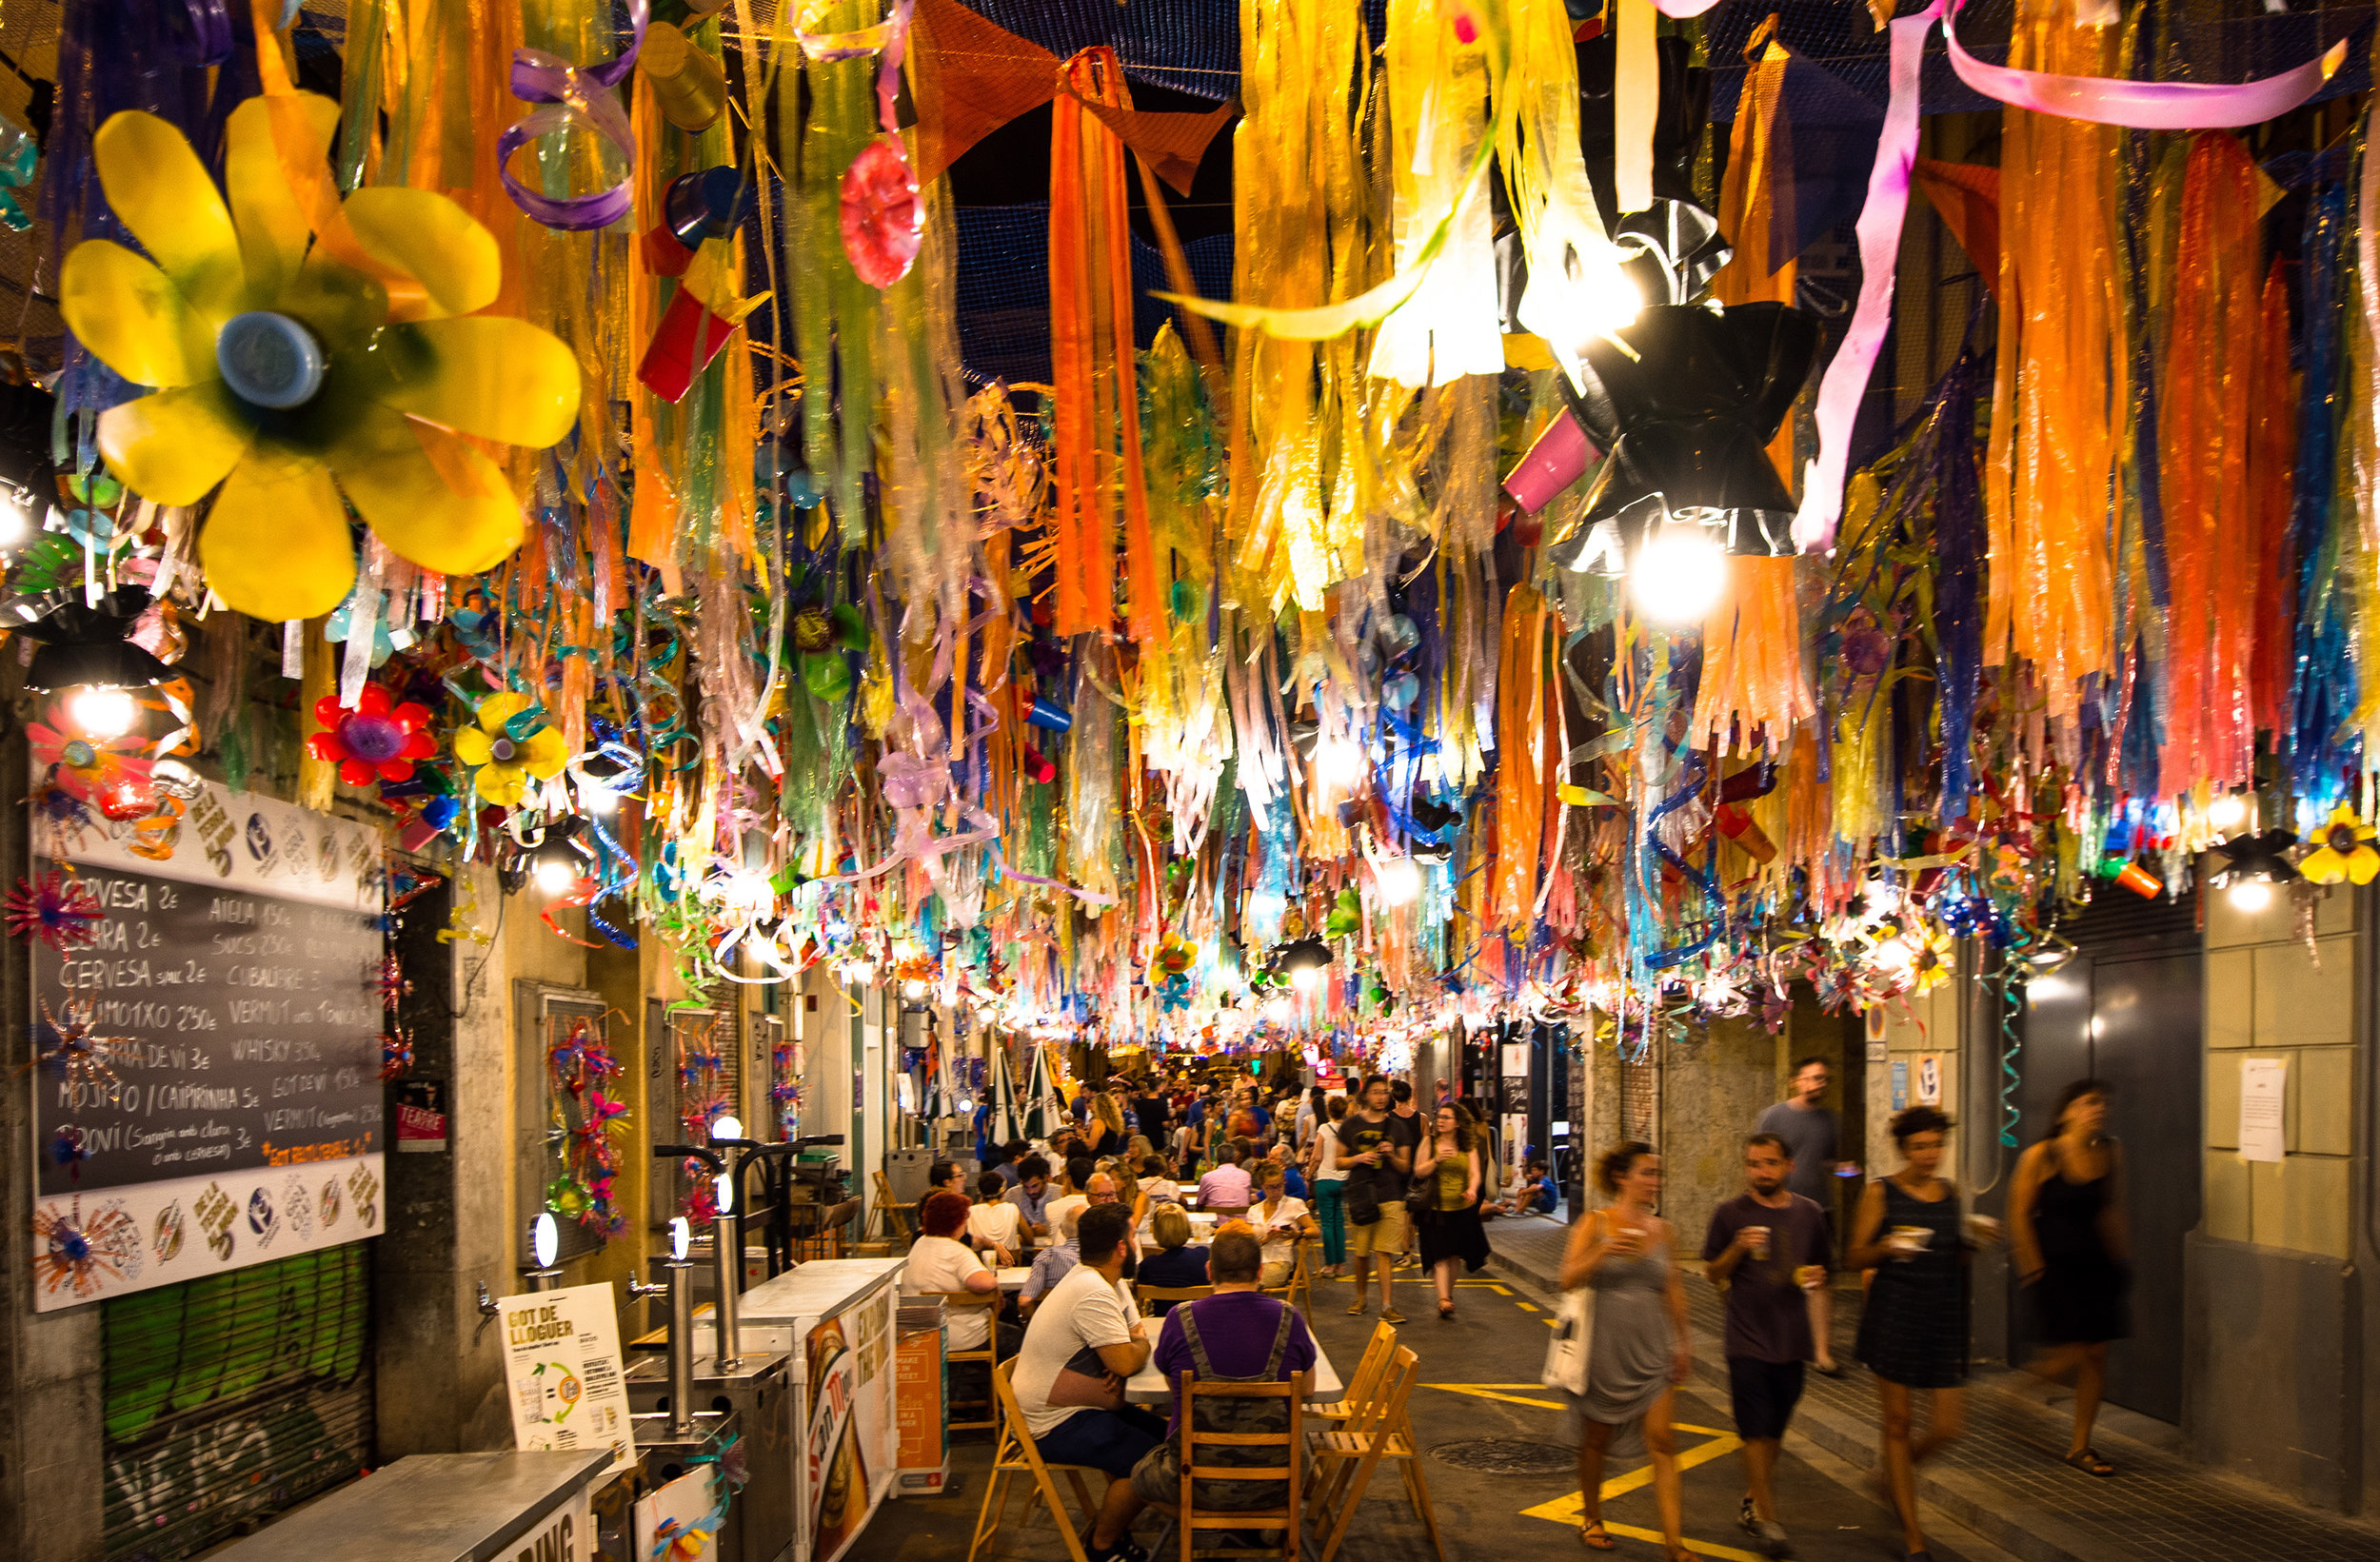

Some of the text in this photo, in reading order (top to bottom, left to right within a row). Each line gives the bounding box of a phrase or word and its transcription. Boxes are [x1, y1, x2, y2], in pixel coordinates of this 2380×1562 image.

[58, 959, 151, 990] CERVESA
[508, 1305, 559, 1329] GOT DE
[509, 1320, 573, 1346] LLOGUER
